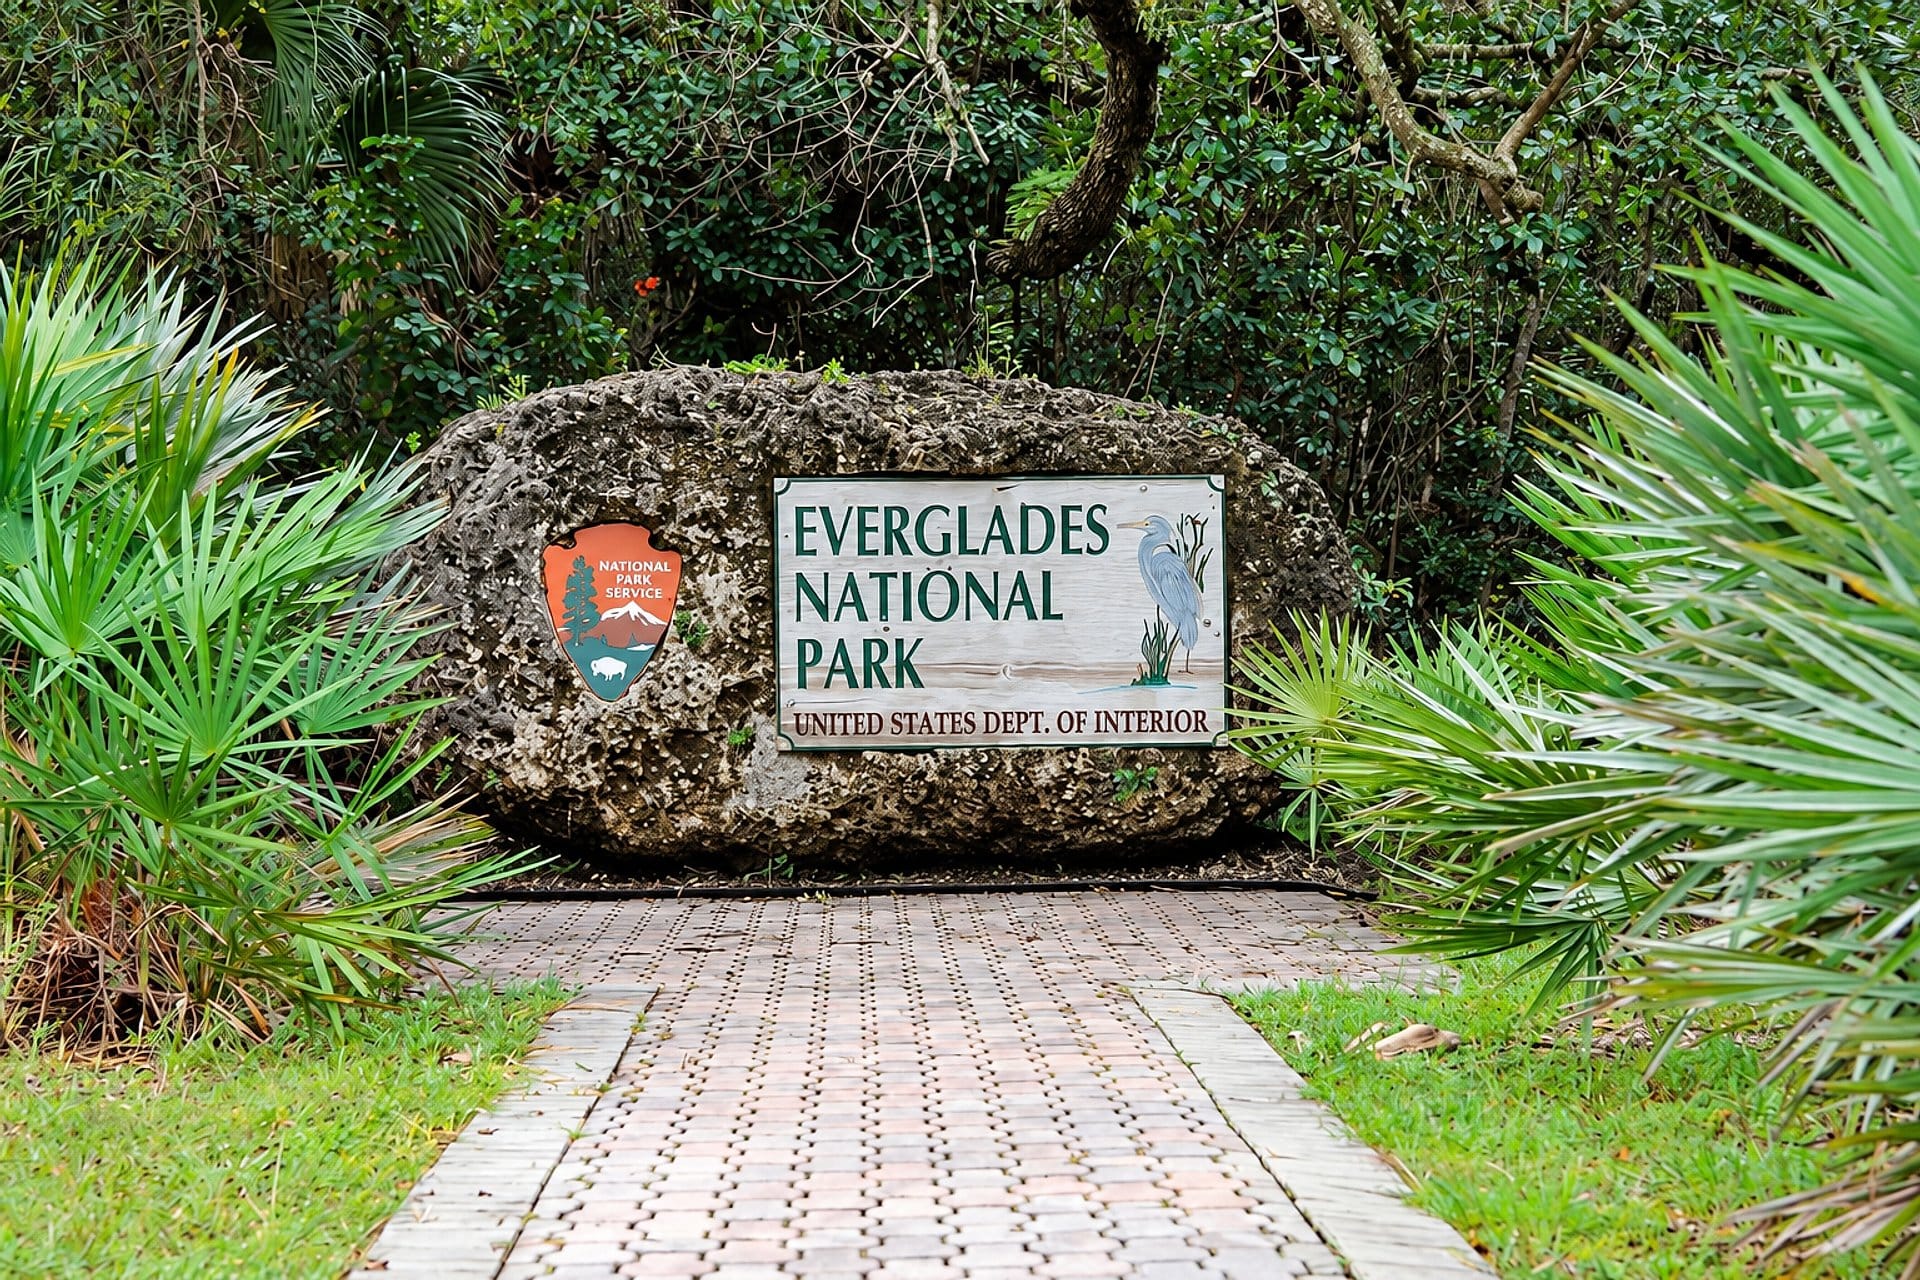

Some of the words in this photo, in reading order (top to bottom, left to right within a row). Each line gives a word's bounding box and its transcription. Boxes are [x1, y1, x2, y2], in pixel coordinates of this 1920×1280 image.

[794, 503, 1111, 556] EVERGLADES
[600, 560, 671, 572] NATIONAL
[616, 573, 652, 585] PARK
[605, 587, 663, 599] SERVICE
[795, 570, 1064, 623] NATIONAL
[796, 637, 925, 690] PARK
[793, 711, 884, 737] UNITED
[890, 711, 977, 735] STATES
[984, 710, 1050, 735] DEPT.
[1056, 709, 1087, 734] OF
[1094, 709, 1209, 734] INTERIOR
